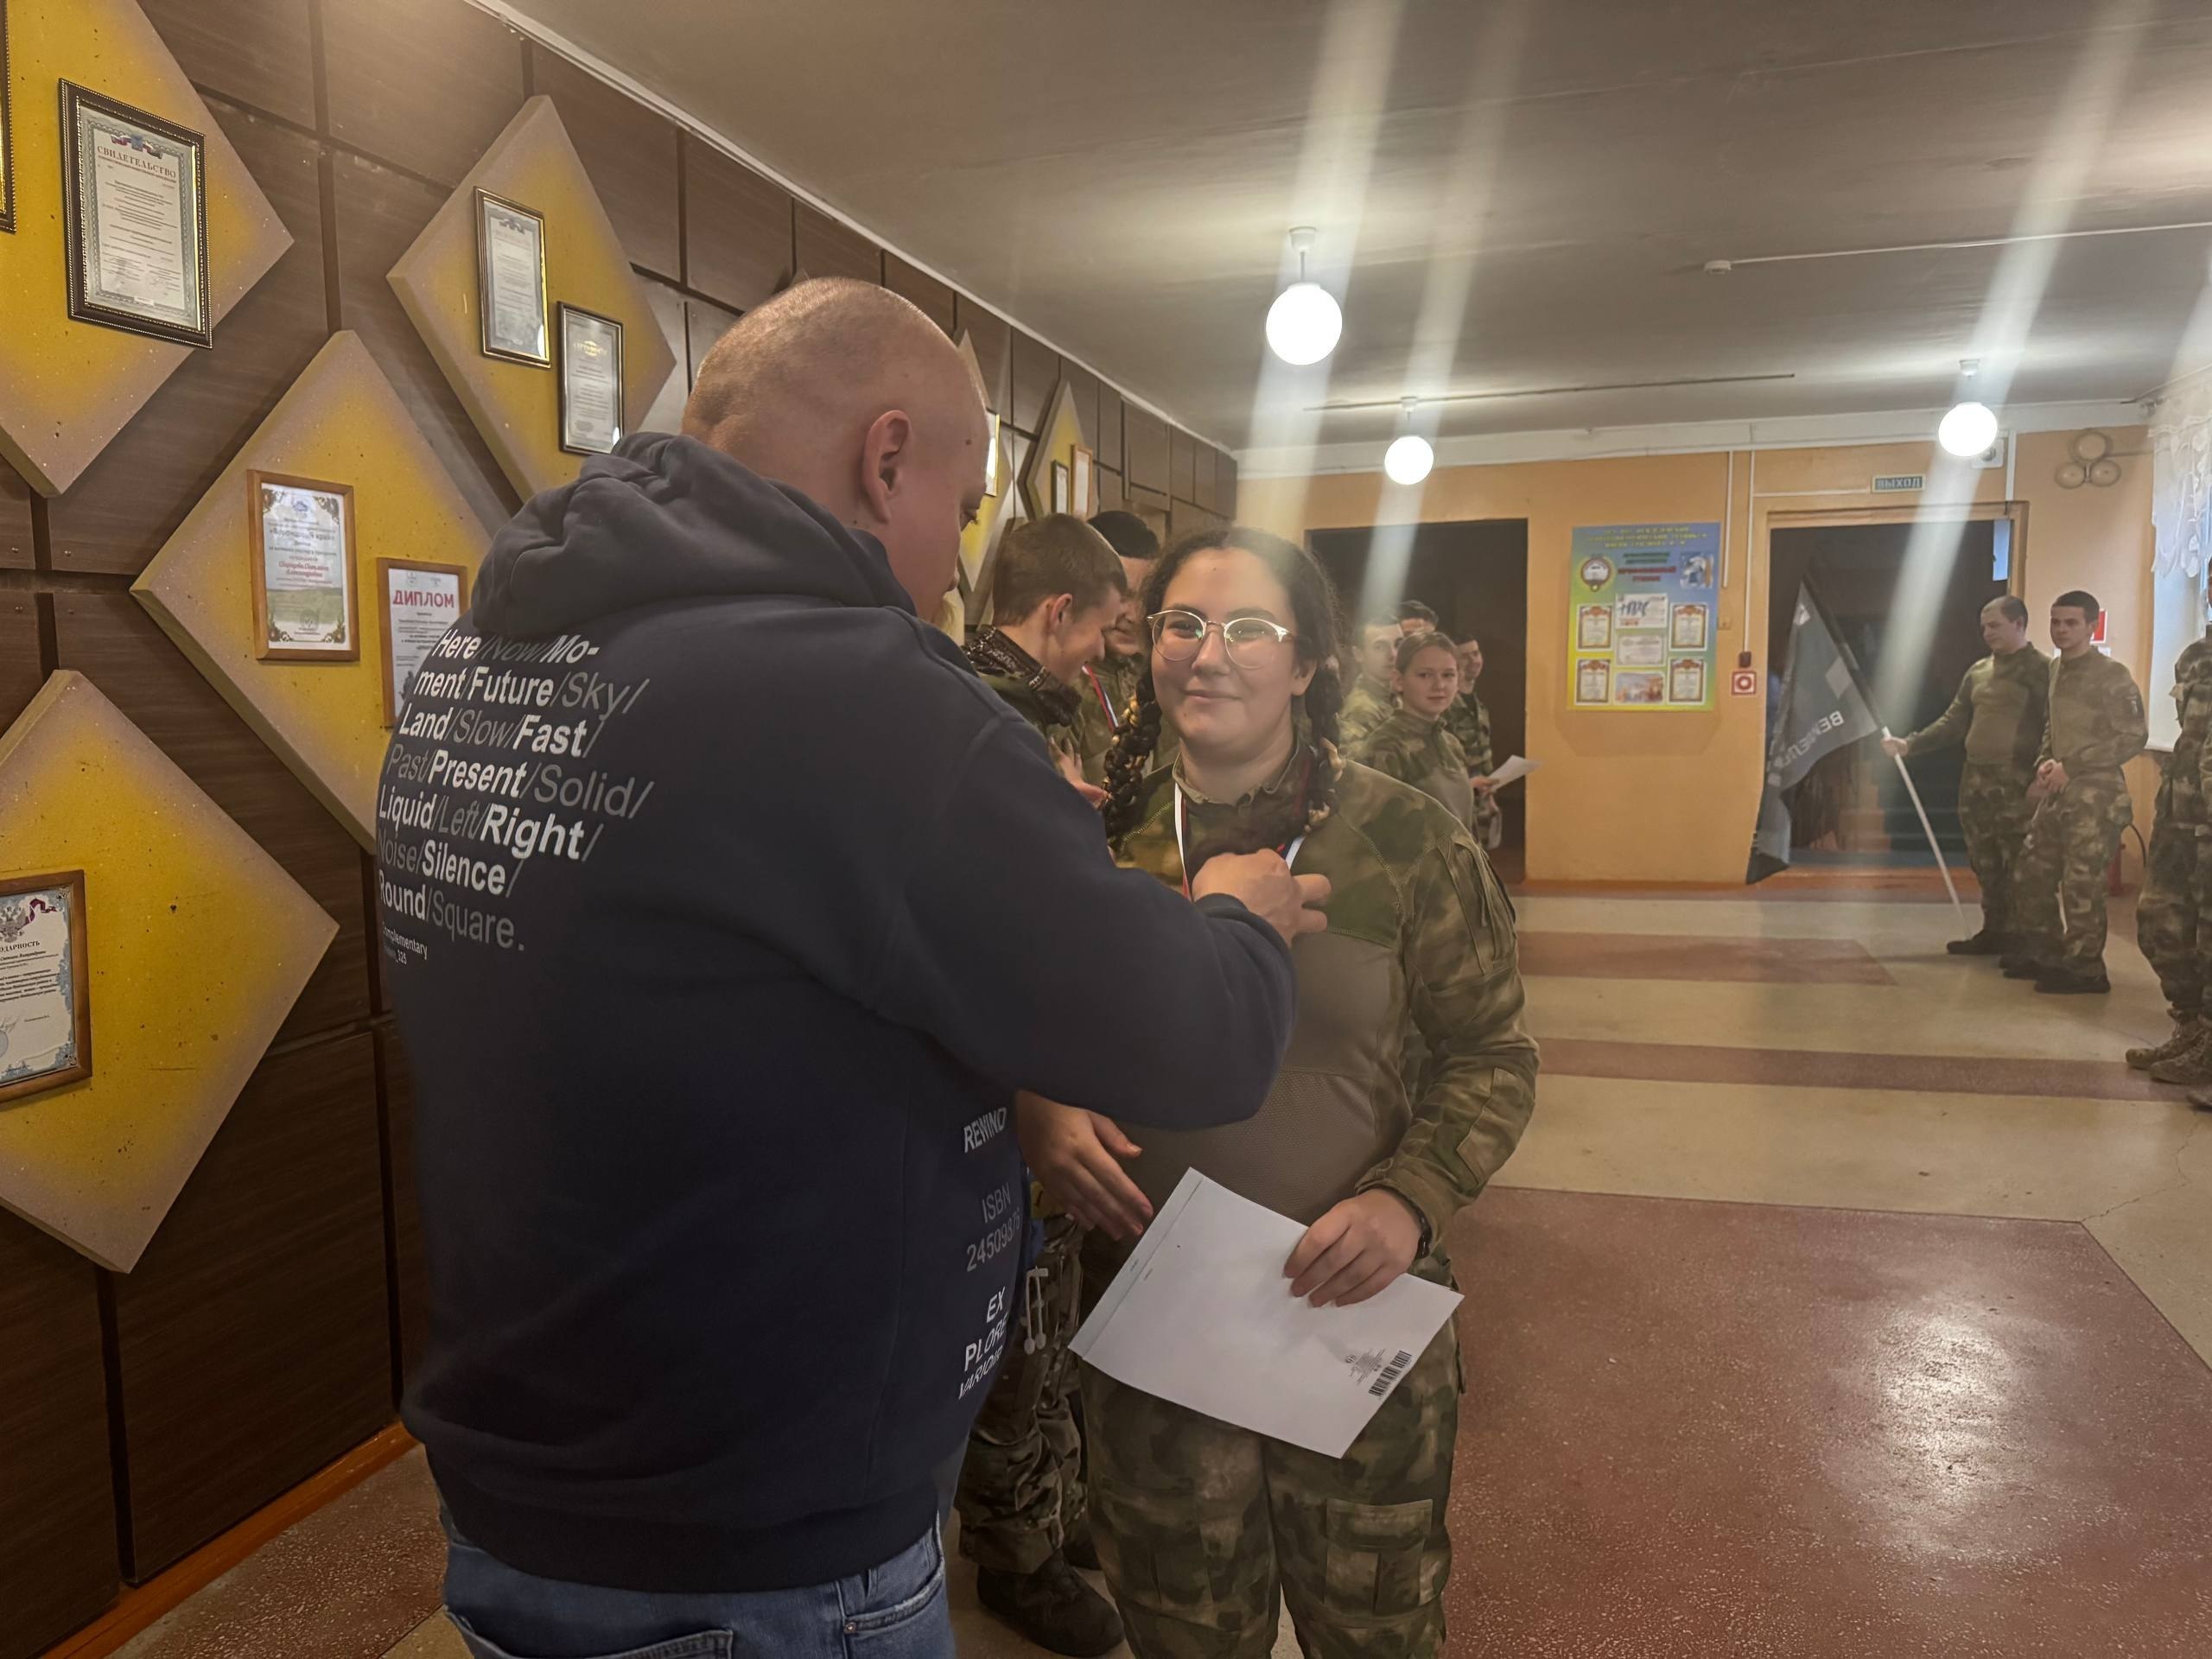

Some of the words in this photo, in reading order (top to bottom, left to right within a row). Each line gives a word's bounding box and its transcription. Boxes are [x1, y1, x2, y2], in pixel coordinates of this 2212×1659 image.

[97, 145, 176, 178] СВИДЕТЕЛЬСТВО
[1876, 477, 1921, 489] ВЫХОД
[392, 589, 454, 608] ДИПЛОМ
[963, 1107, 1007, 1154] REWIND
[982, 1181, 1011, 1224] ISBN
[986, 1286, 1005, 1323] EX
